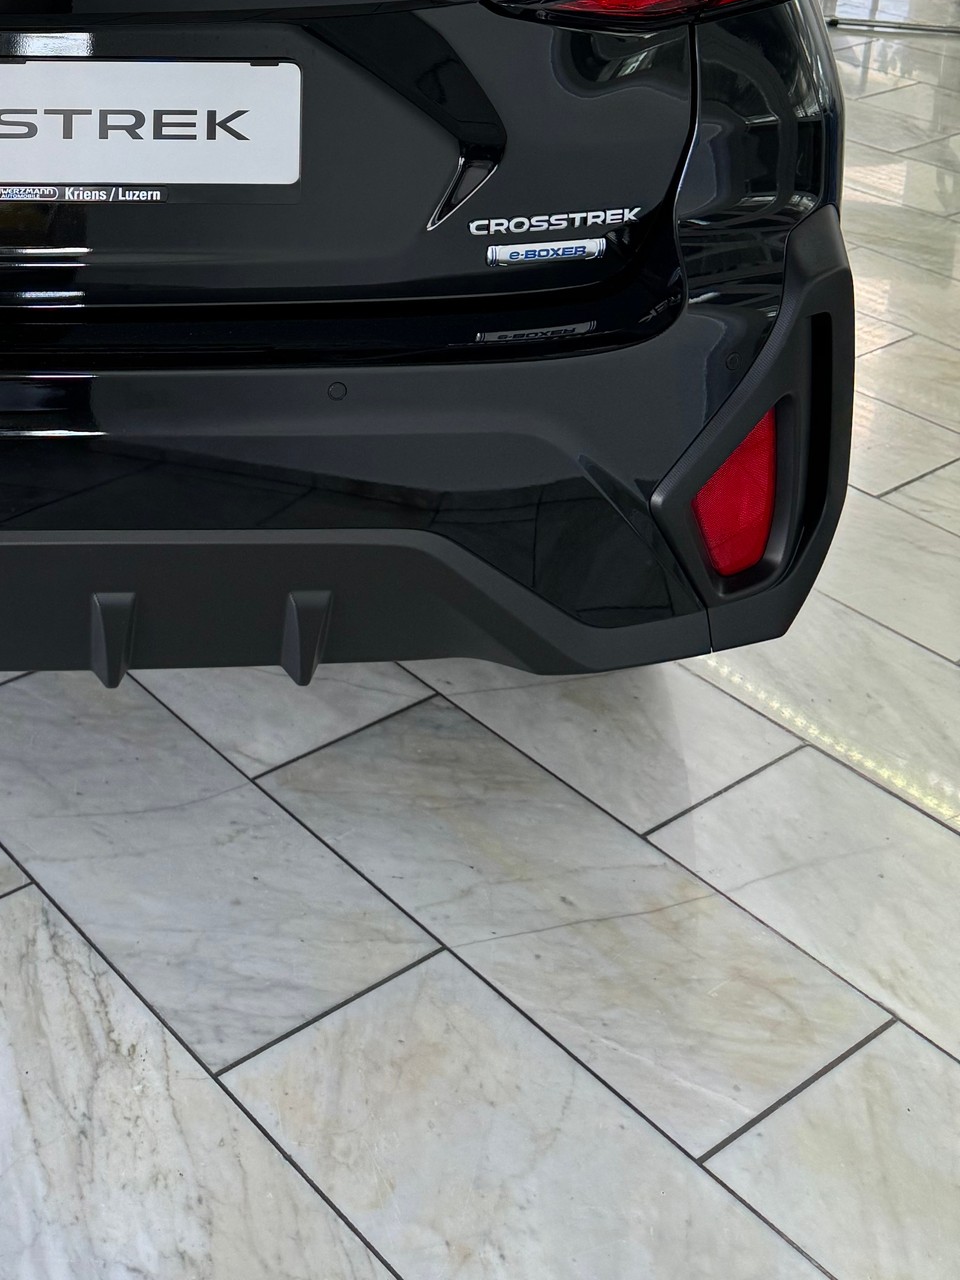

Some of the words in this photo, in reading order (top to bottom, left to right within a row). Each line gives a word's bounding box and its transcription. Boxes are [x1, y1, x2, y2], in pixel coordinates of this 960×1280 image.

[65, 186, 106, 200] Kriens
[109, 187, 115, 201] /
[118, 187, 161, 200] Luzern
[469, 207, 642, 236] CROSSTREK
[508, 245, 587, 260] e-BOXER
